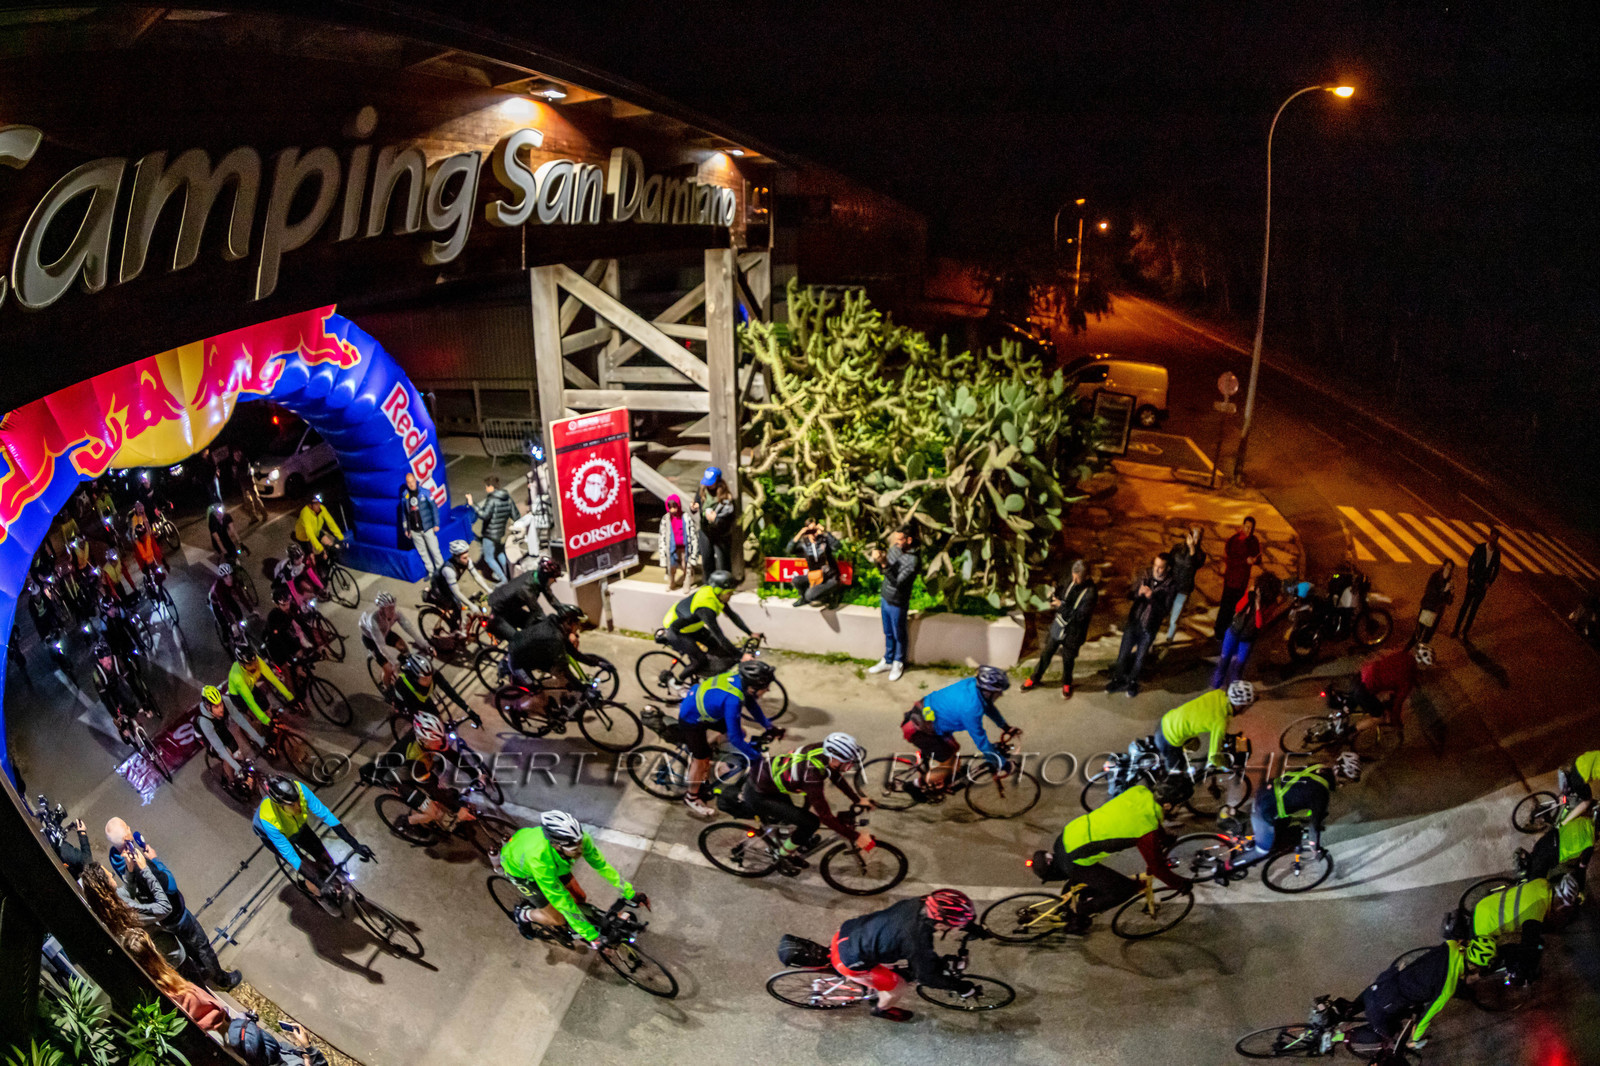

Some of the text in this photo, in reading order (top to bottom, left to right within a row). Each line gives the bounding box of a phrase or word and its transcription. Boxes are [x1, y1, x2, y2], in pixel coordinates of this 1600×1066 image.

[0, 105, 736, 309] amping San Damiano
[380, 381, 428, 459] Red
[569, 519, 631, 550] CORSICA
